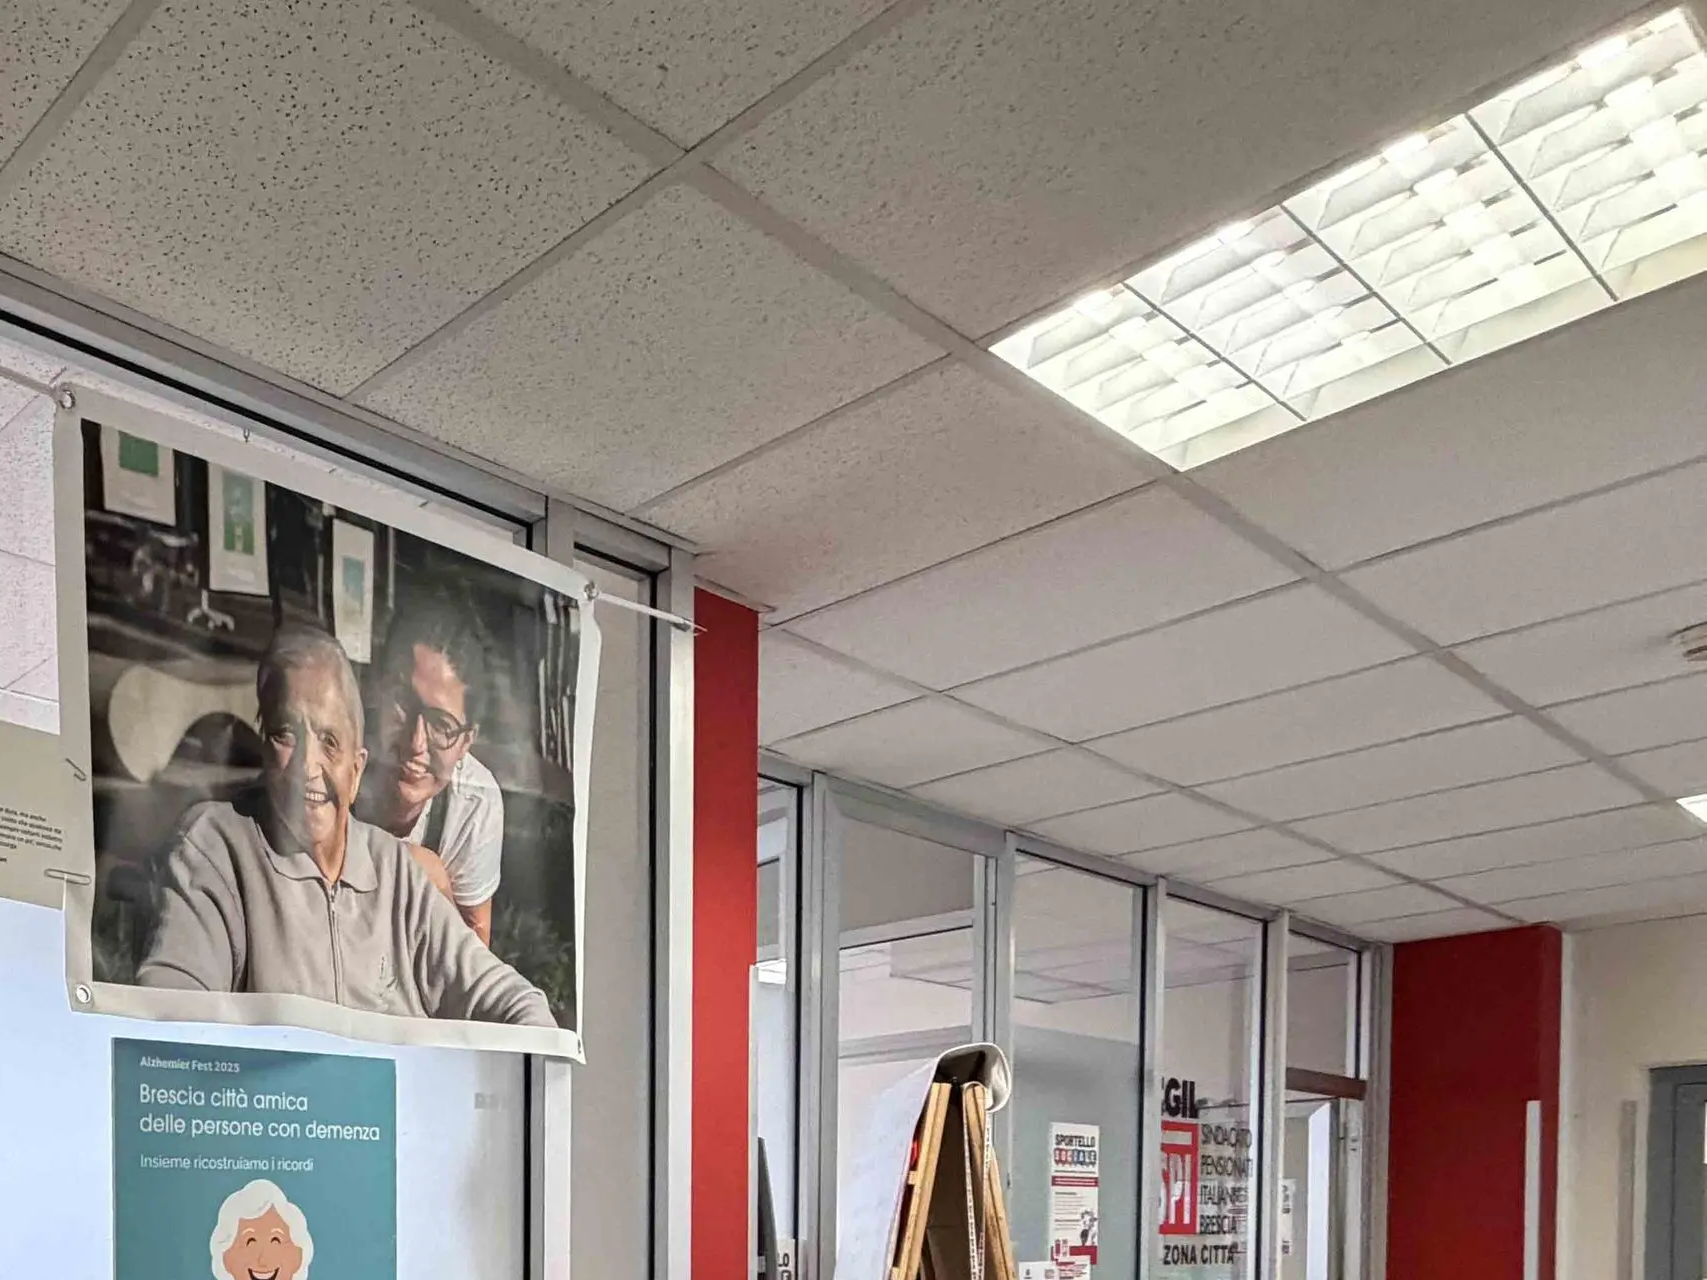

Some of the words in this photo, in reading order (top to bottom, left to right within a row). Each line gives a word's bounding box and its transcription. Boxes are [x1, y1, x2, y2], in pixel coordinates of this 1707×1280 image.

[192, 1060, 213, 1072] Fest
[214, 1061, 240, 1073] 2025
[139, 1083, 205, 1106] Brescia
[210, 1087, 248, 1108] città
[253, 1091, 308, 1111] amica
[1160, 1077, 1199, 1119] GIL
[139, 1113, 186, 1133] delle
[191, 1119, 263, 1138] persone
[268, 1122, 301, 1138] con
[305, 1120, 380, 1141] demenza
[1055, 1134, 1096, 1147] SPORTELLO
[140, 1154, 191, 1169] Insieme
[193, 1155, 269, 1170] ricostruiamo
[277, 1158, 314, 1171] ricordi
[1163, 1244, 1197, 1265] ZONA
